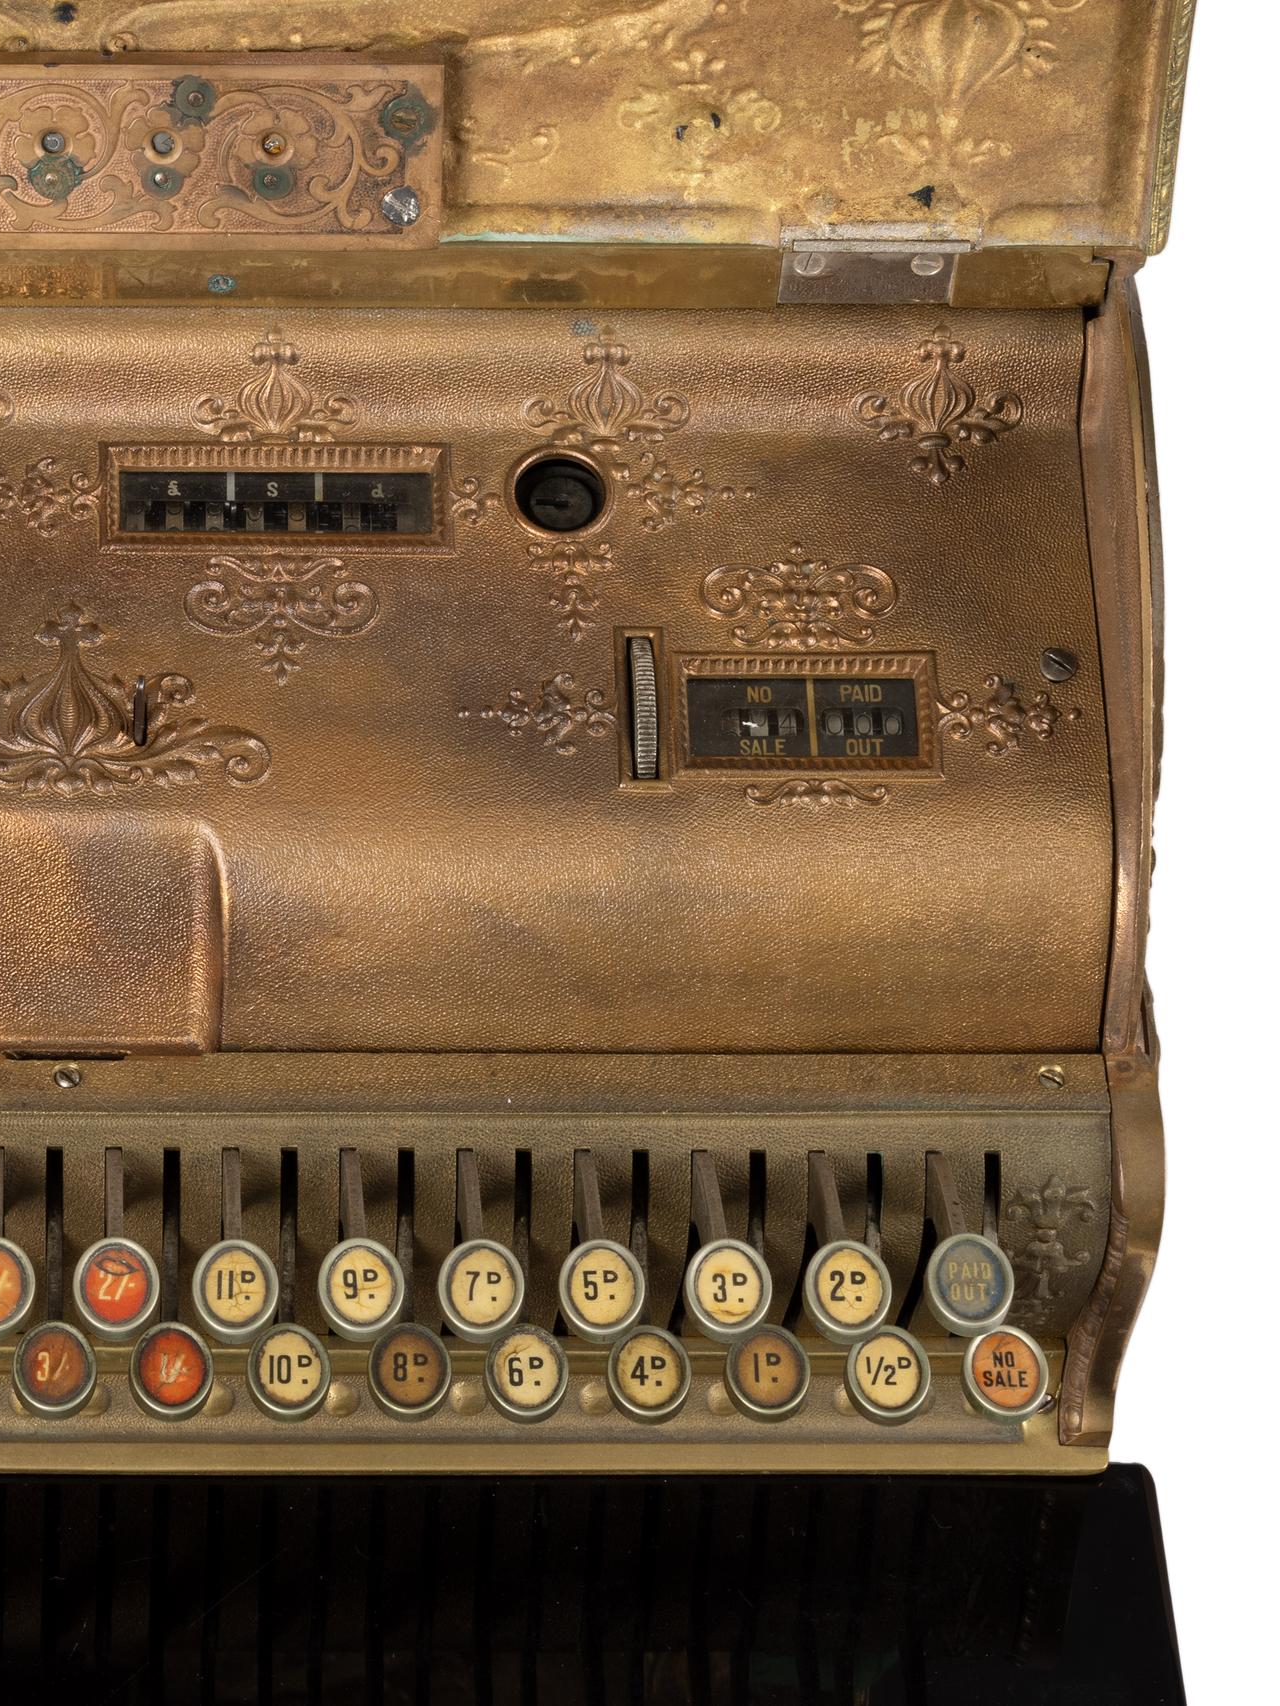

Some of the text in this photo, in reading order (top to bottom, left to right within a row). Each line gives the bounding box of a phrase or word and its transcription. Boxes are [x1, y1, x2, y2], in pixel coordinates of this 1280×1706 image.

[747, 686, 772, 703] NO
[840, 684, 882, 702] PAID
[740, 740, 786, 756] SALE
[846, 740, 883, 755] OUT
[948, 1262, 992, 1281] PAID
[950, 1283, 987, 1300] OUT
[992, 1351, 1015, 1368] NO
[983, 1371, 1029, 1388] SALE
